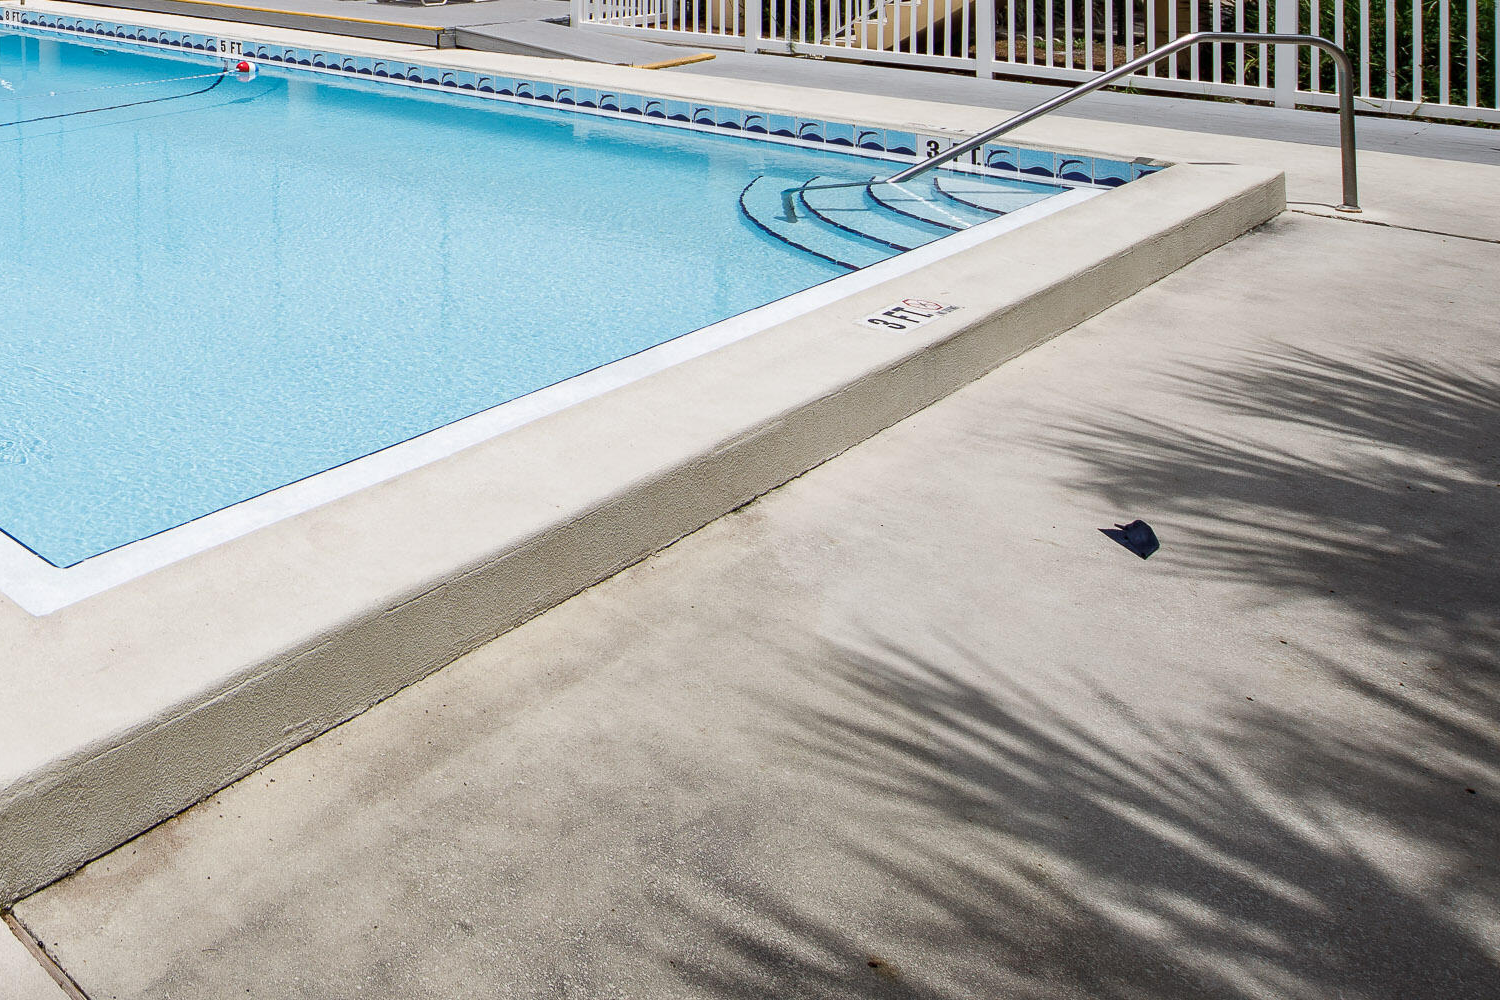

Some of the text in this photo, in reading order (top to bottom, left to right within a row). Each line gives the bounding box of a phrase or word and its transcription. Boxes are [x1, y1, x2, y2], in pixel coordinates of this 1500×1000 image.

[5, 10, 10, 21] 8
[220, 39, 227, 53] 5
[926, 140, 940, 159] 3
[867, 318, 907, 330] 3
